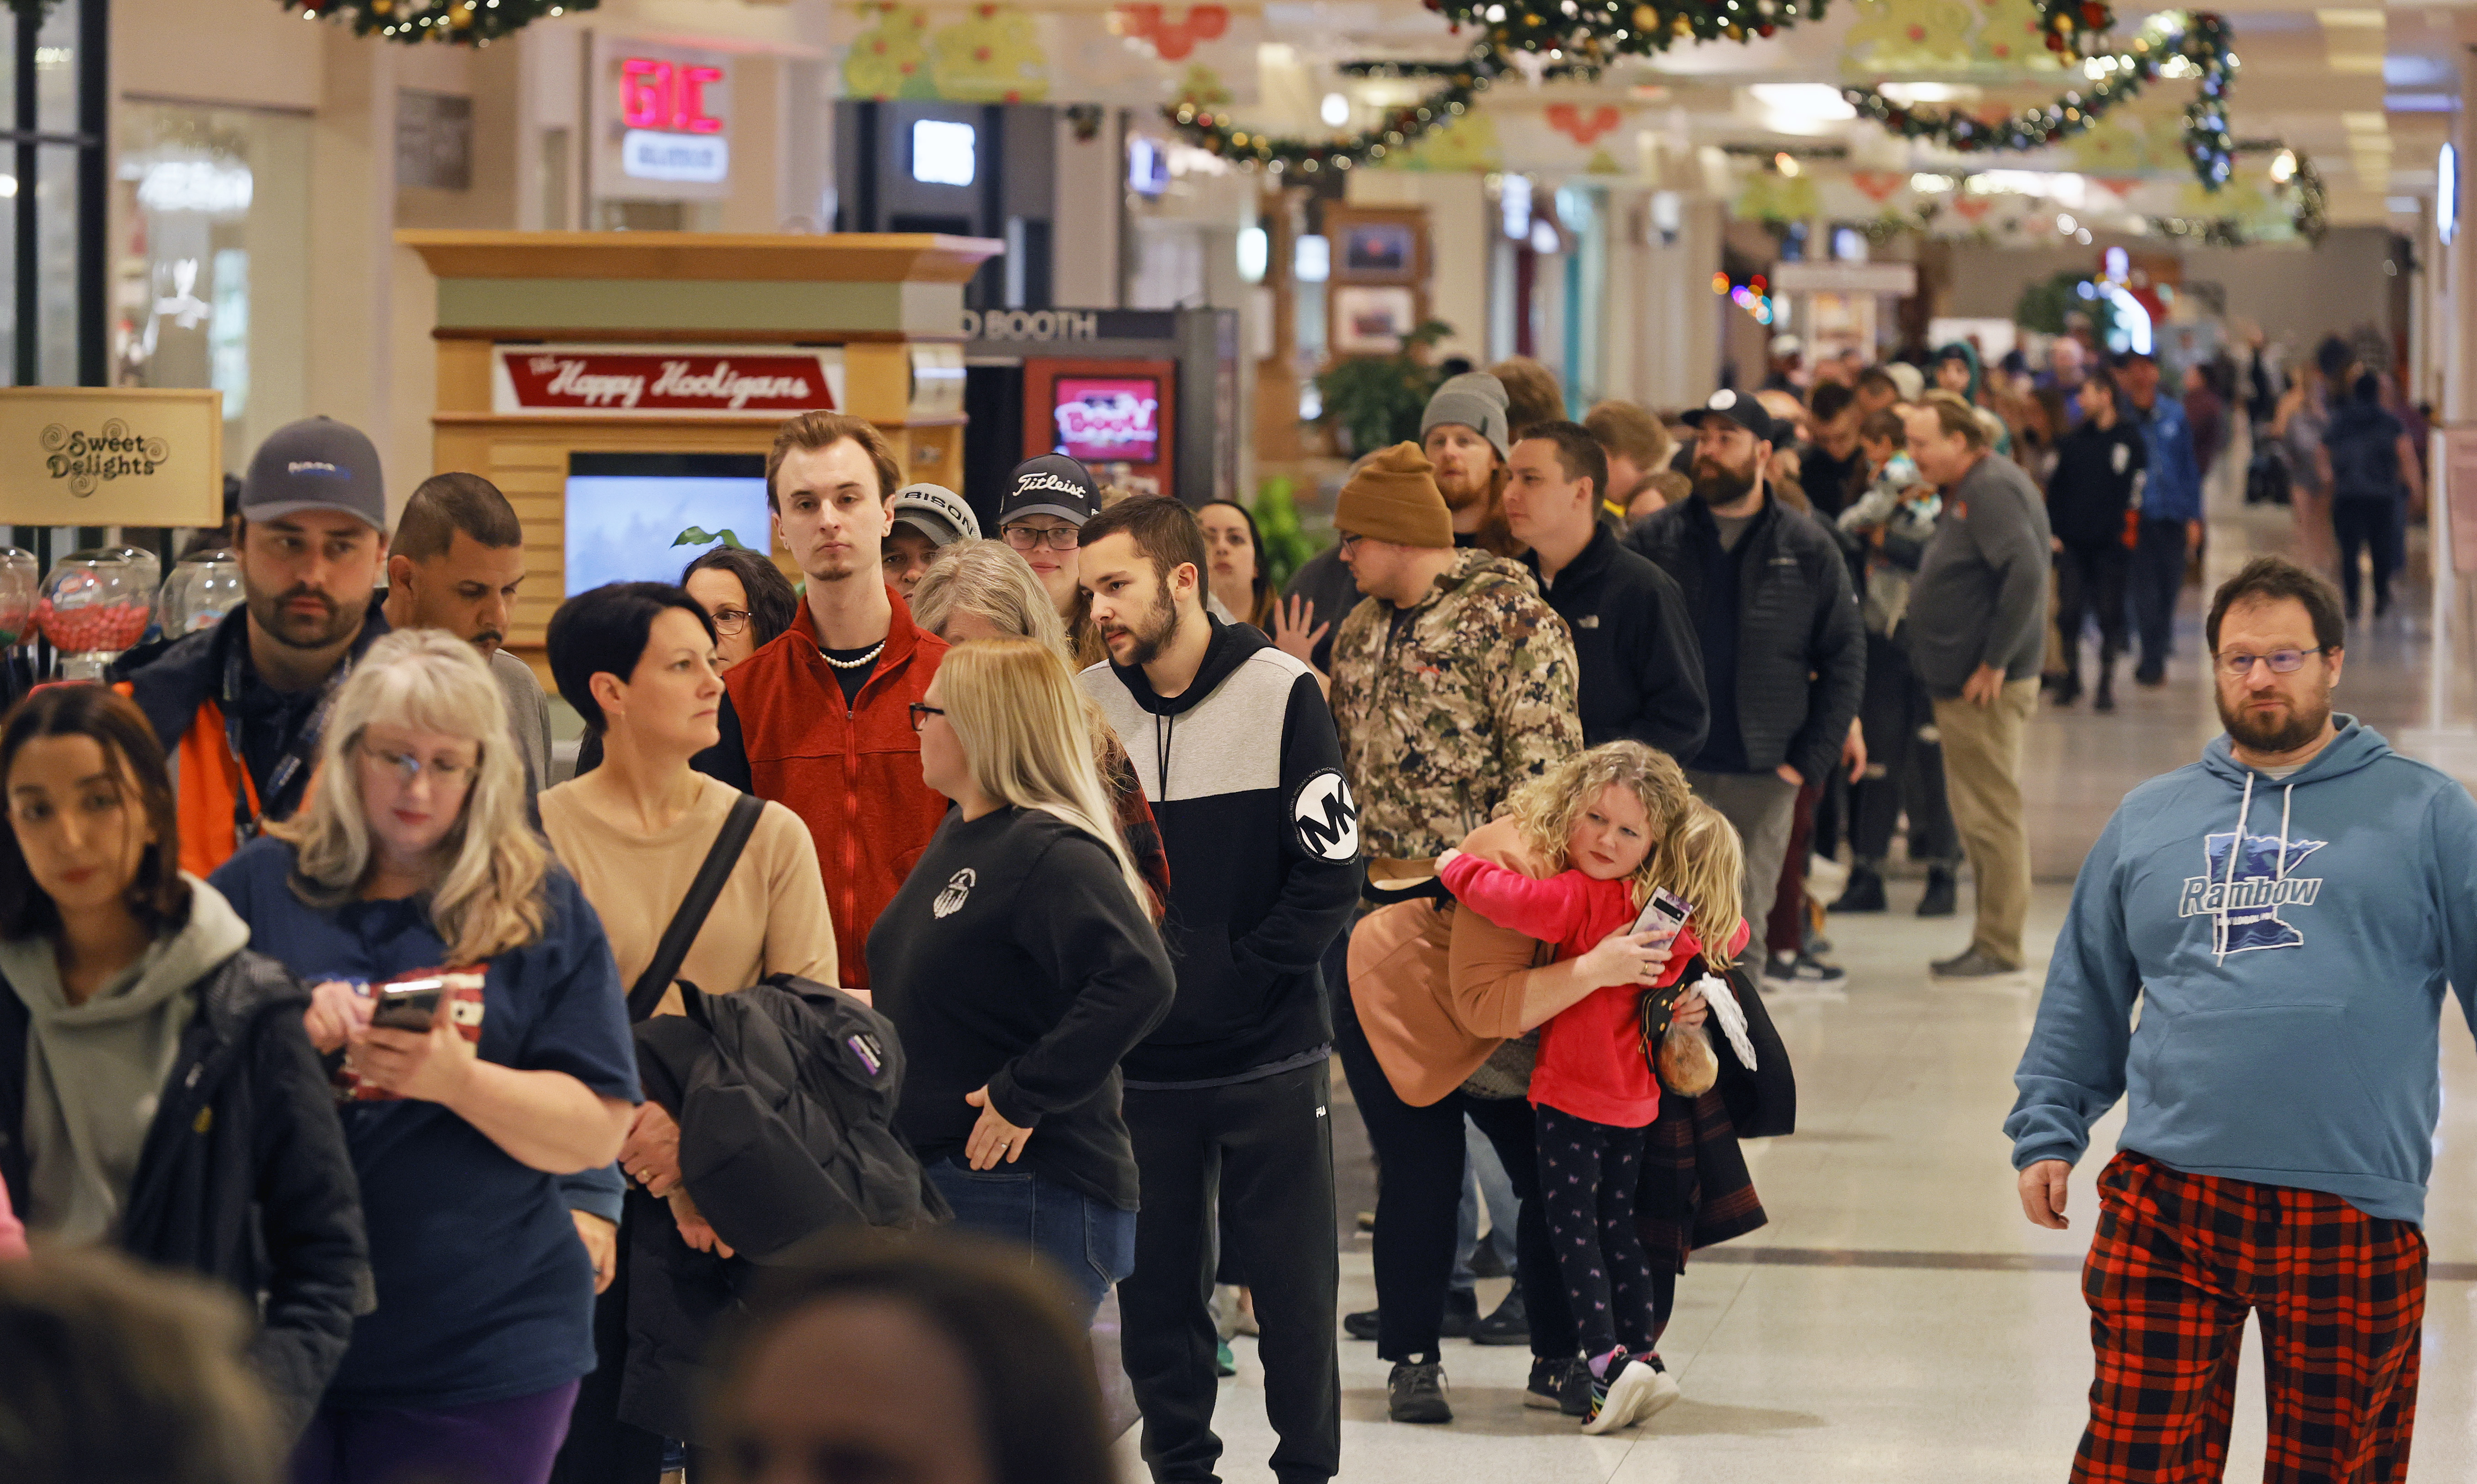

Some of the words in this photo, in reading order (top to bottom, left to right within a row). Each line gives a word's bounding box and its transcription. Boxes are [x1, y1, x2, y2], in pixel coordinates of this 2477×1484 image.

[985, 310, 1096, 340] BOOTH
[547, 359, 645, 407] Happy
[651, 360, 809, 408] Hooligans
[69, 430, 144, 457] Sweet
[47, 454, 155, 480] Delights
[1012, 471, 1086, 499] Titleist
[904, 491, 973, 535] BISON
[1308, 769, 1321, 778] KORS
[1297, 778, 1356, 855] MK
[2178, 875, 2323, 918] Rambow
[1316, 1105, 1326, 1118] FILA
